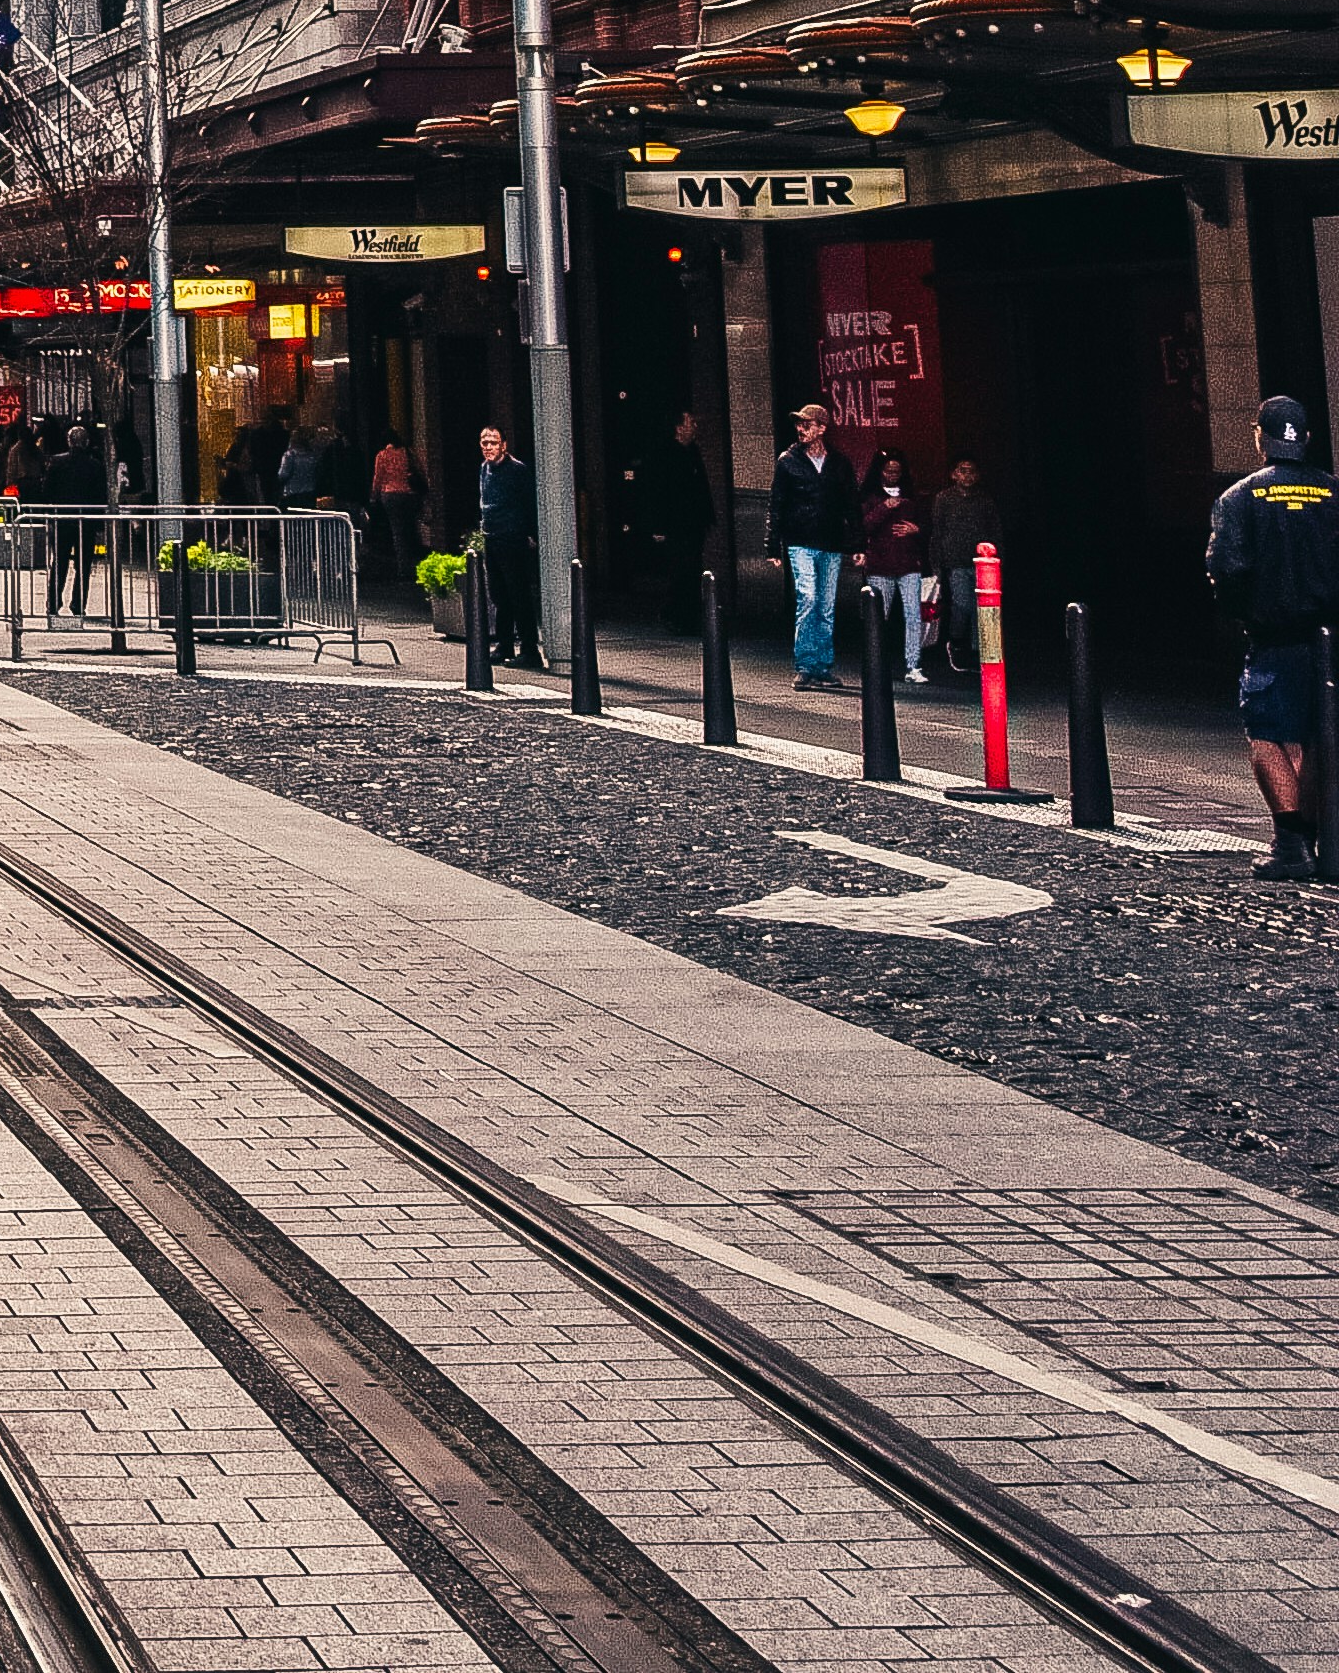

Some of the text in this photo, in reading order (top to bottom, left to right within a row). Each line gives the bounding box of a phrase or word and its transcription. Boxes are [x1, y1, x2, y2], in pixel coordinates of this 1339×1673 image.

[1252, 99, 1339, 149] West
[677, 175, 856, 207] MYER
[348, 228, 422, 253] Westfield
[178, 285, 251, 296] TATIONERY
[831, 380, 899, 427] SALE
